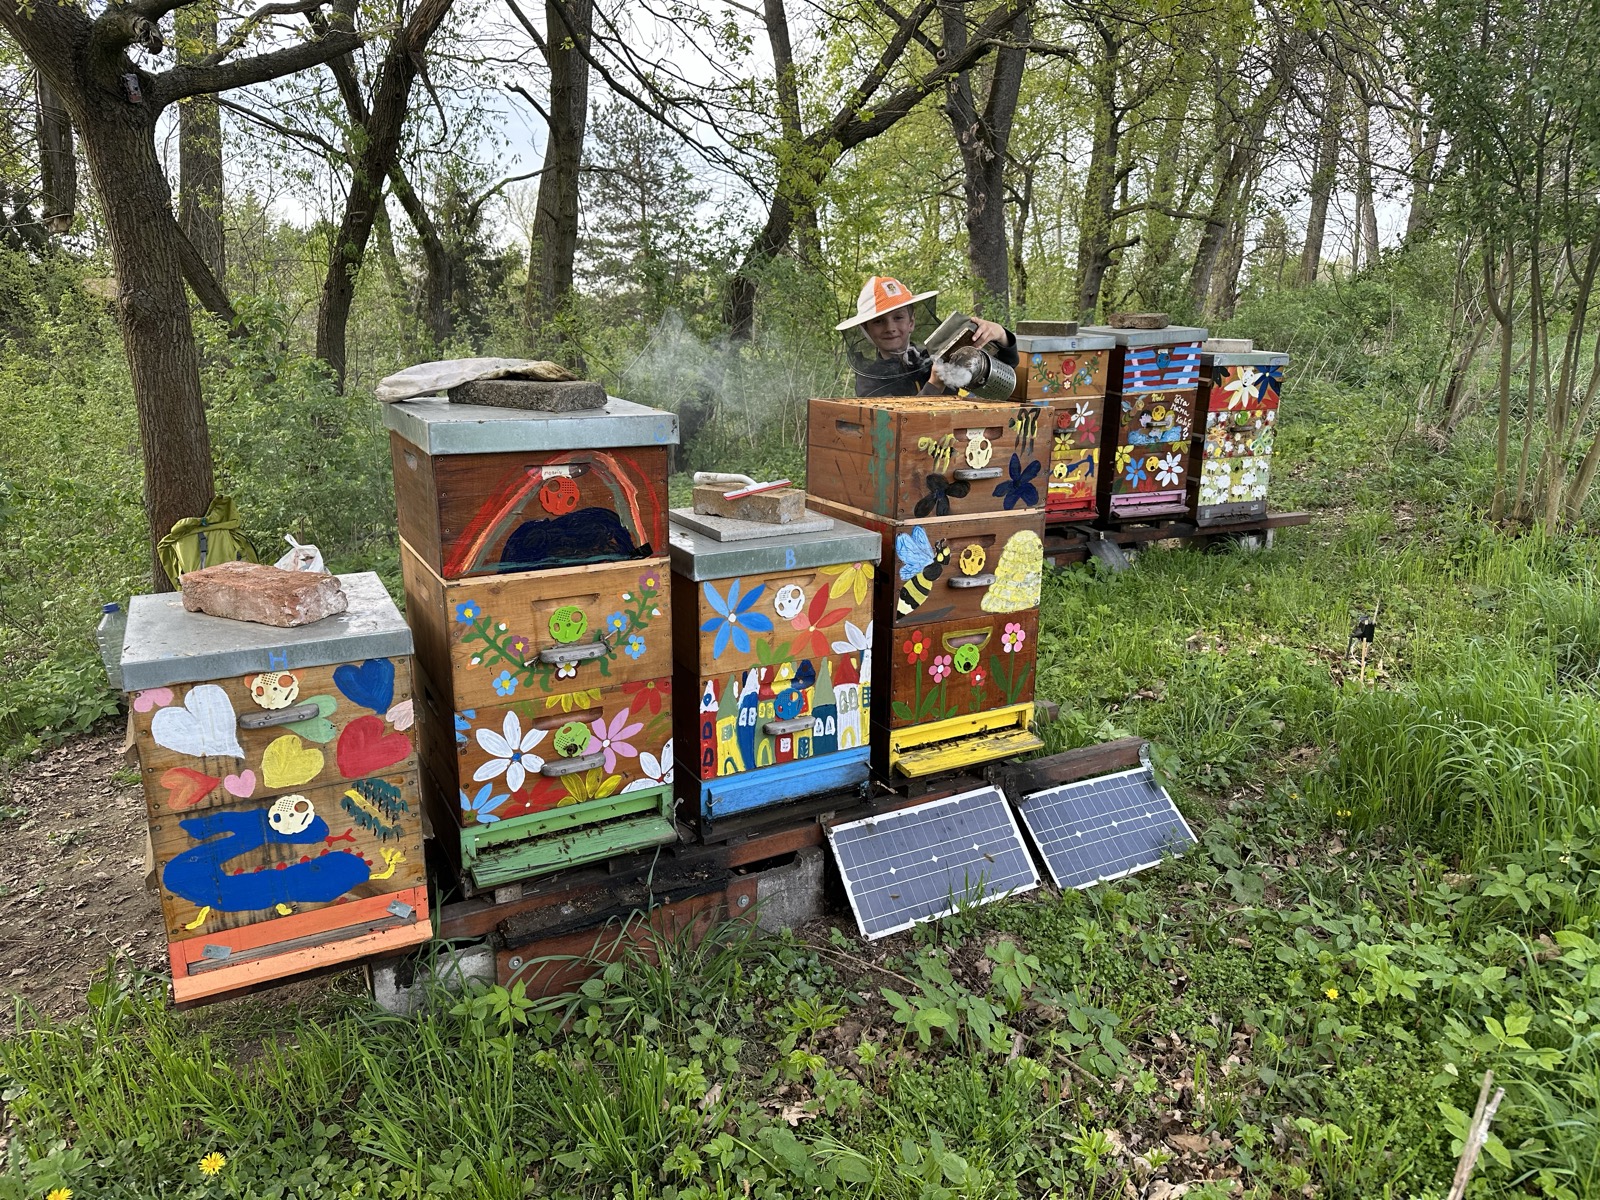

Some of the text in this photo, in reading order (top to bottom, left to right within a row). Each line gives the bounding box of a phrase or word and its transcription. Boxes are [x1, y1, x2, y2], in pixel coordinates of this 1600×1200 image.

[1071, 341, 1076, 349] E
[785, 548, 796, 570] B
[268, 650, 288, 671] H
